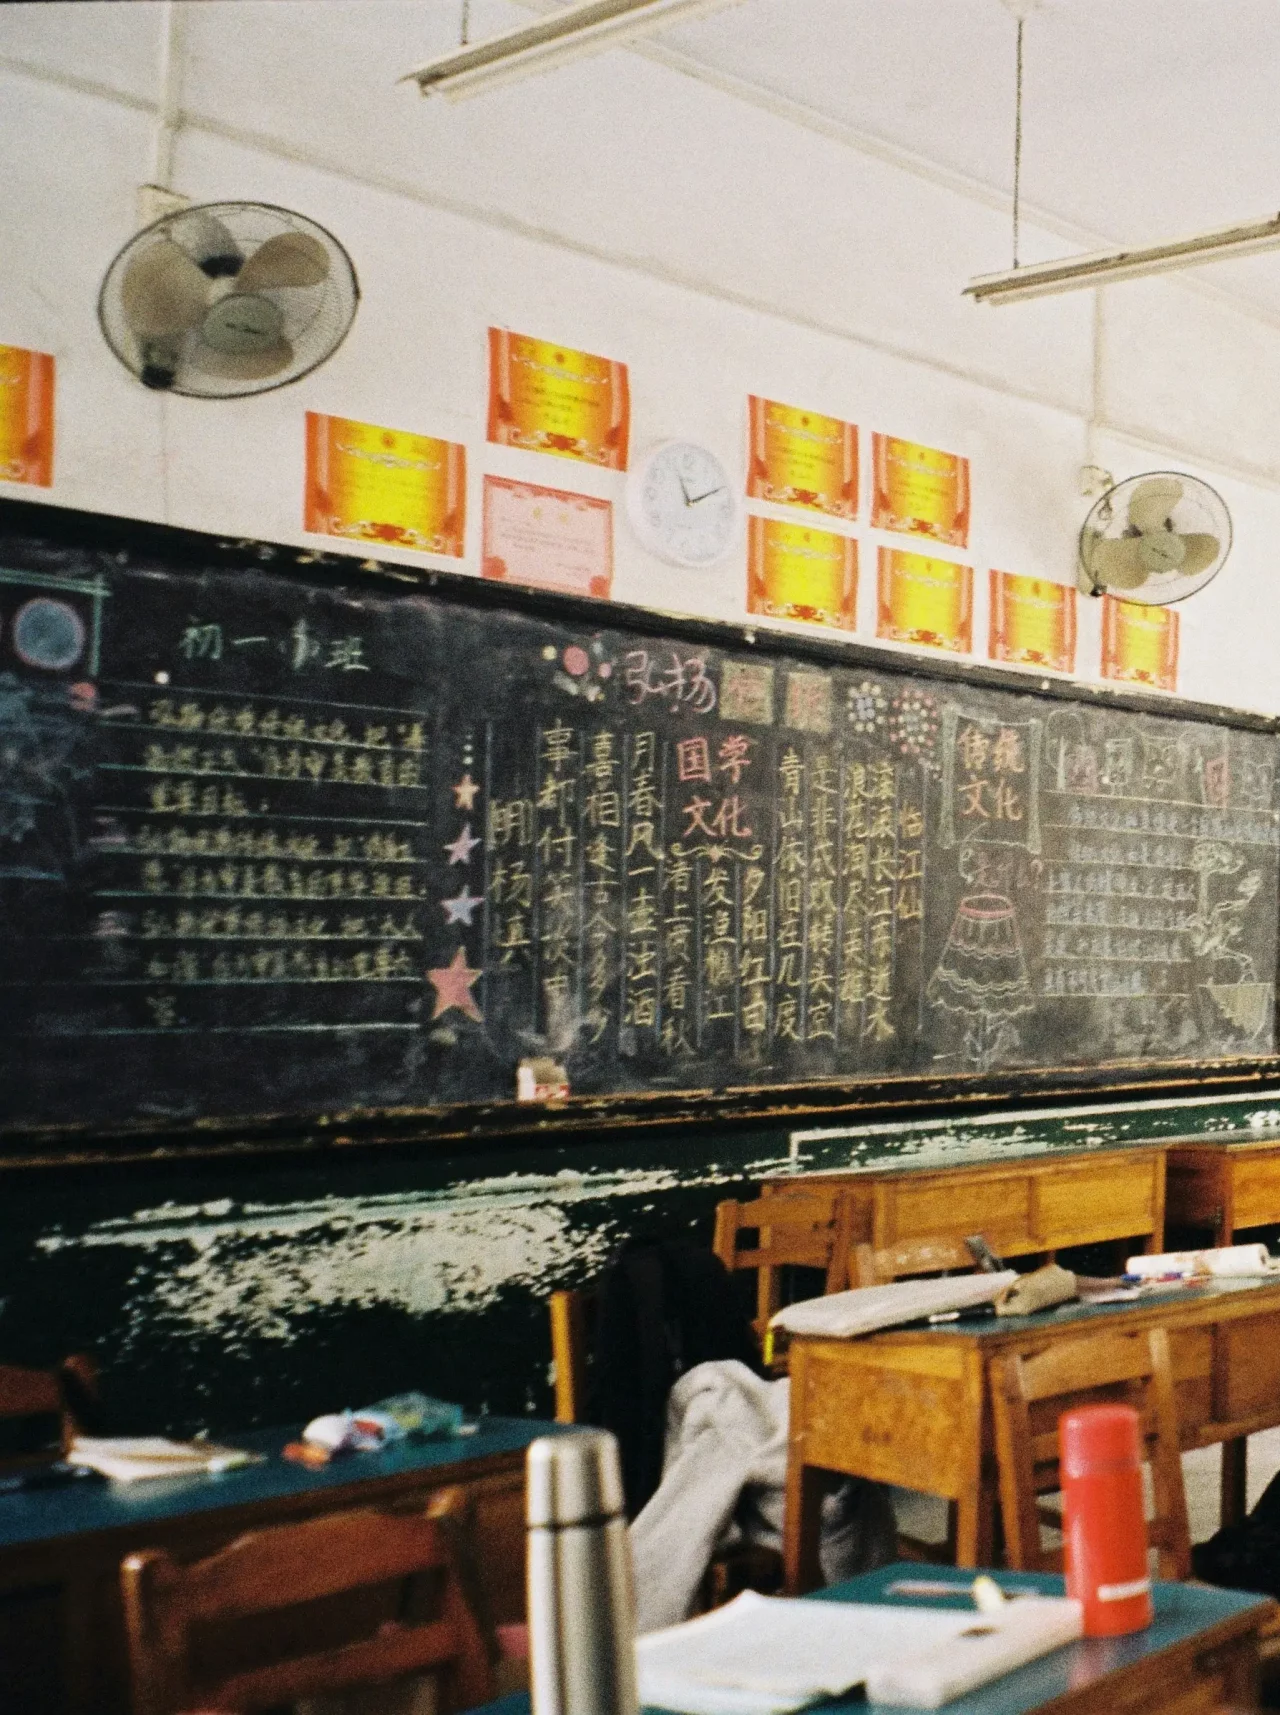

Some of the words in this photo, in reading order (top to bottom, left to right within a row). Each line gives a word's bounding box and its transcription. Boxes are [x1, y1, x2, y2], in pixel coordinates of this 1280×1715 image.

[677, 733, 751, 783] 国学
[682, 794, 752, 838] 文化
[957, 774, 1025, 822] 文化
